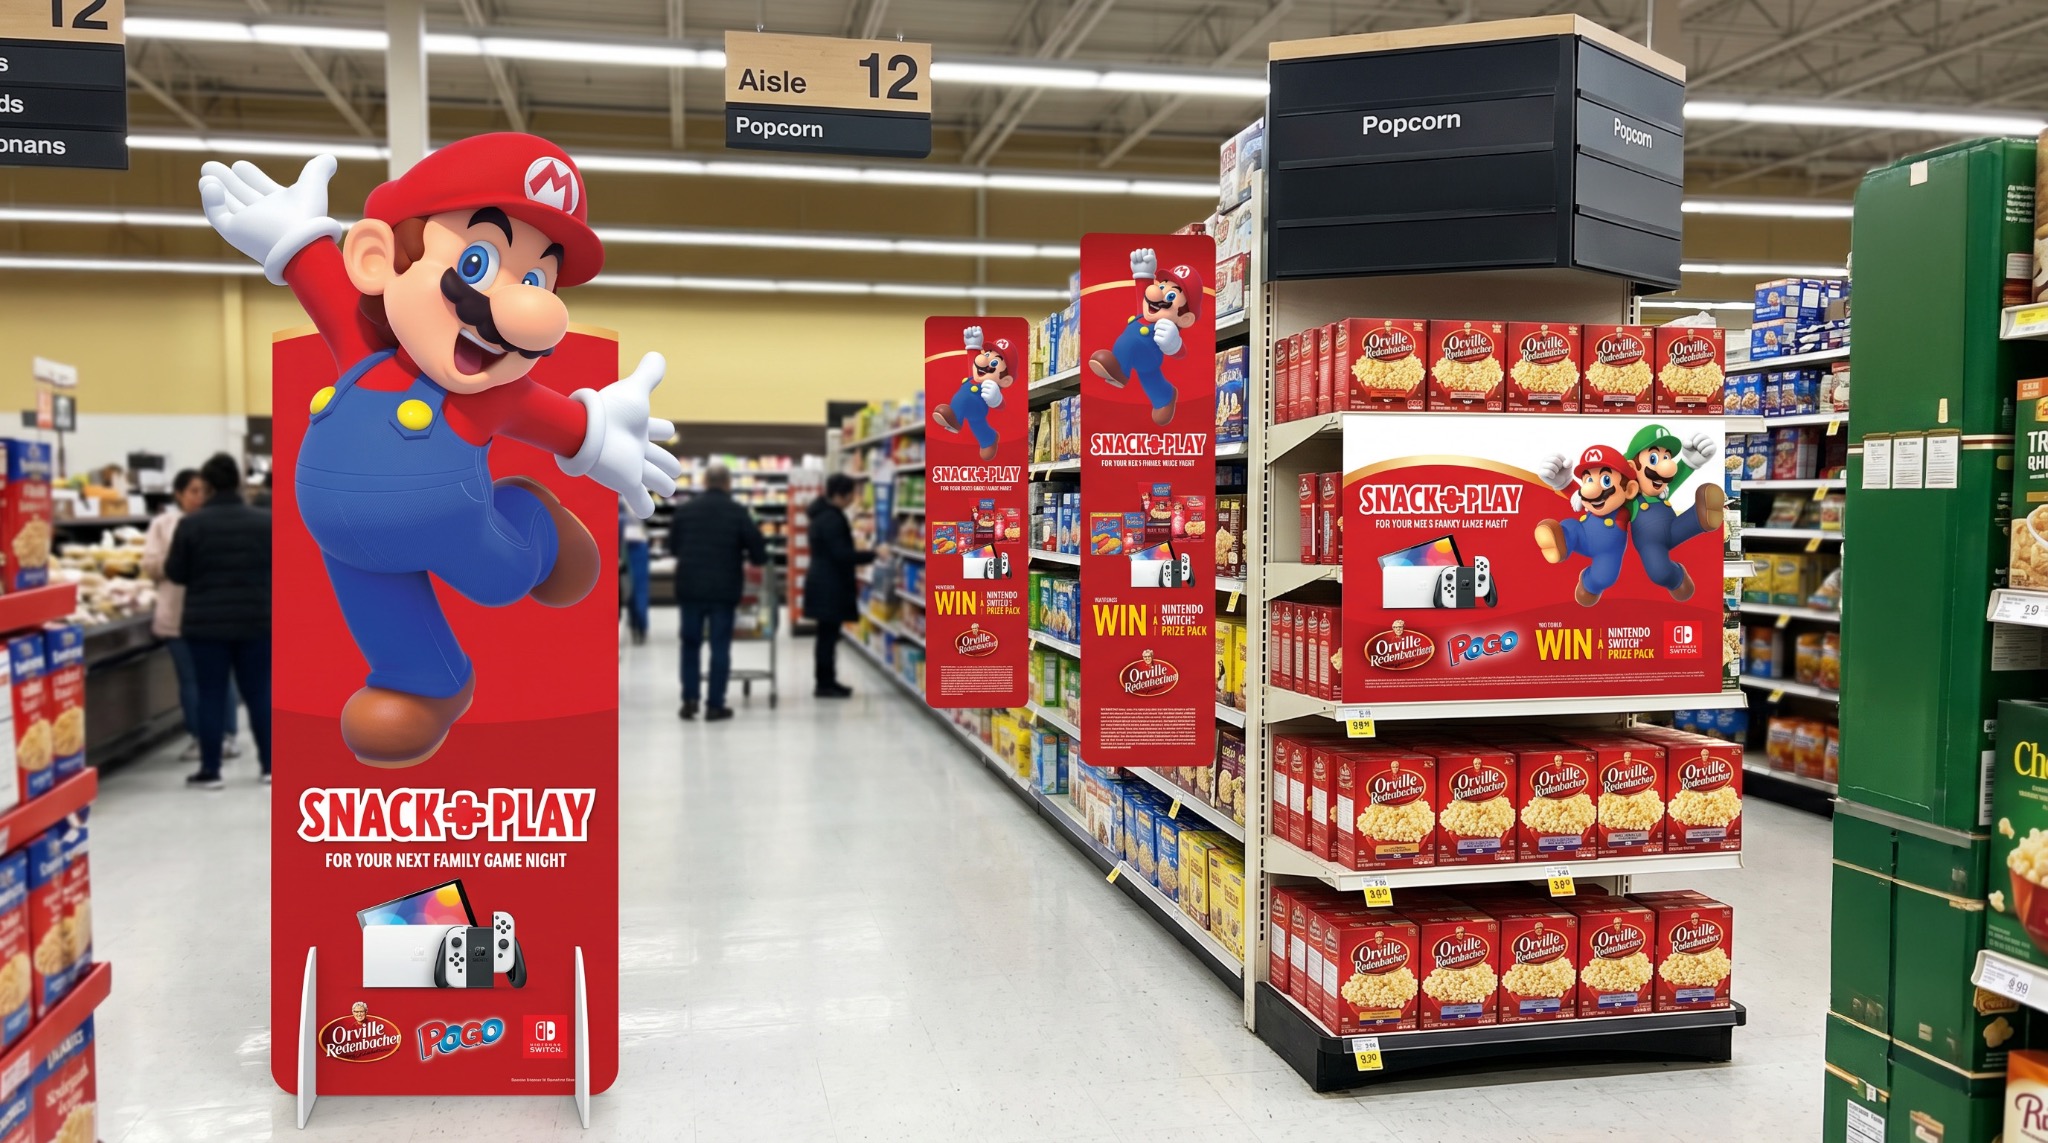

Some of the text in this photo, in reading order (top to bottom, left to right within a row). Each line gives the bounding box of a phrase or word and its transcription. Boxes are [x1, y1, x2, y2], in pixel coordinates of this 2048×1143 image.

[738, 53, 918, 101] Aisle 12
[736, 116, 824, 139] Popcorn
[1363, 113, 1461, 138] Popcorn
[1613, 117, 1652, 149] Popcorn
[1369, 332, 1408, 348] Orville
[1526, 336, 1563, 351] Orville
[1602, 338, 1637, 352] Orville
[1674, 340, 1709, 355] Orville
[1090, 433, 1207, 456] SNACK PLAY
[933, 466, 1021, 483] SNACK PLAY
[1359, 484, 1523, 515] SNACK PLAY
[1376, 519, 1391, 529] FOR
[1392, 519, 1412, 529] YOUR
[934, 591, 977, 615] WIN
[1162, 604, 1203, 614] NINTENDO
[1092, 604, 1147, 636] WIN
[962, 634, 990, 647] Orville
[1162, 626, 1207, 636] PRIZE PACK
[1608, 627, 1650, 638] NINTENDO
[1376, 635, 1421, 655] Orville
[1535, 628, 1604, 661] WIN A
[1608, 648, 1655, 660] PRIZE PACK
[1129, 664, 1167, 683] Orville
[1539, 767, 1580, 786] Orville
[1607, 763, 1649, 782] Orville
[1685, 760, 1726, 779] Orville
[1375, 774, 1417, 793] Orville
[1458, 770, 1499, 789] Orville
[297, 787, 596, 842] SNACK PLAY
[325, 853, 567, 868] FOR YOUR NEXT FAMILY GAME NIGHT
[1519, 932, 1560, 953] Orville
[1598, 928, 1638, 948] Orville
[1676, 923, 1716, 943] Orville
[1359, 942, 1401, 962] Orville
[1440, 937, 1481, 958] Orville
[332, 1020, 385, 1044] Orville
